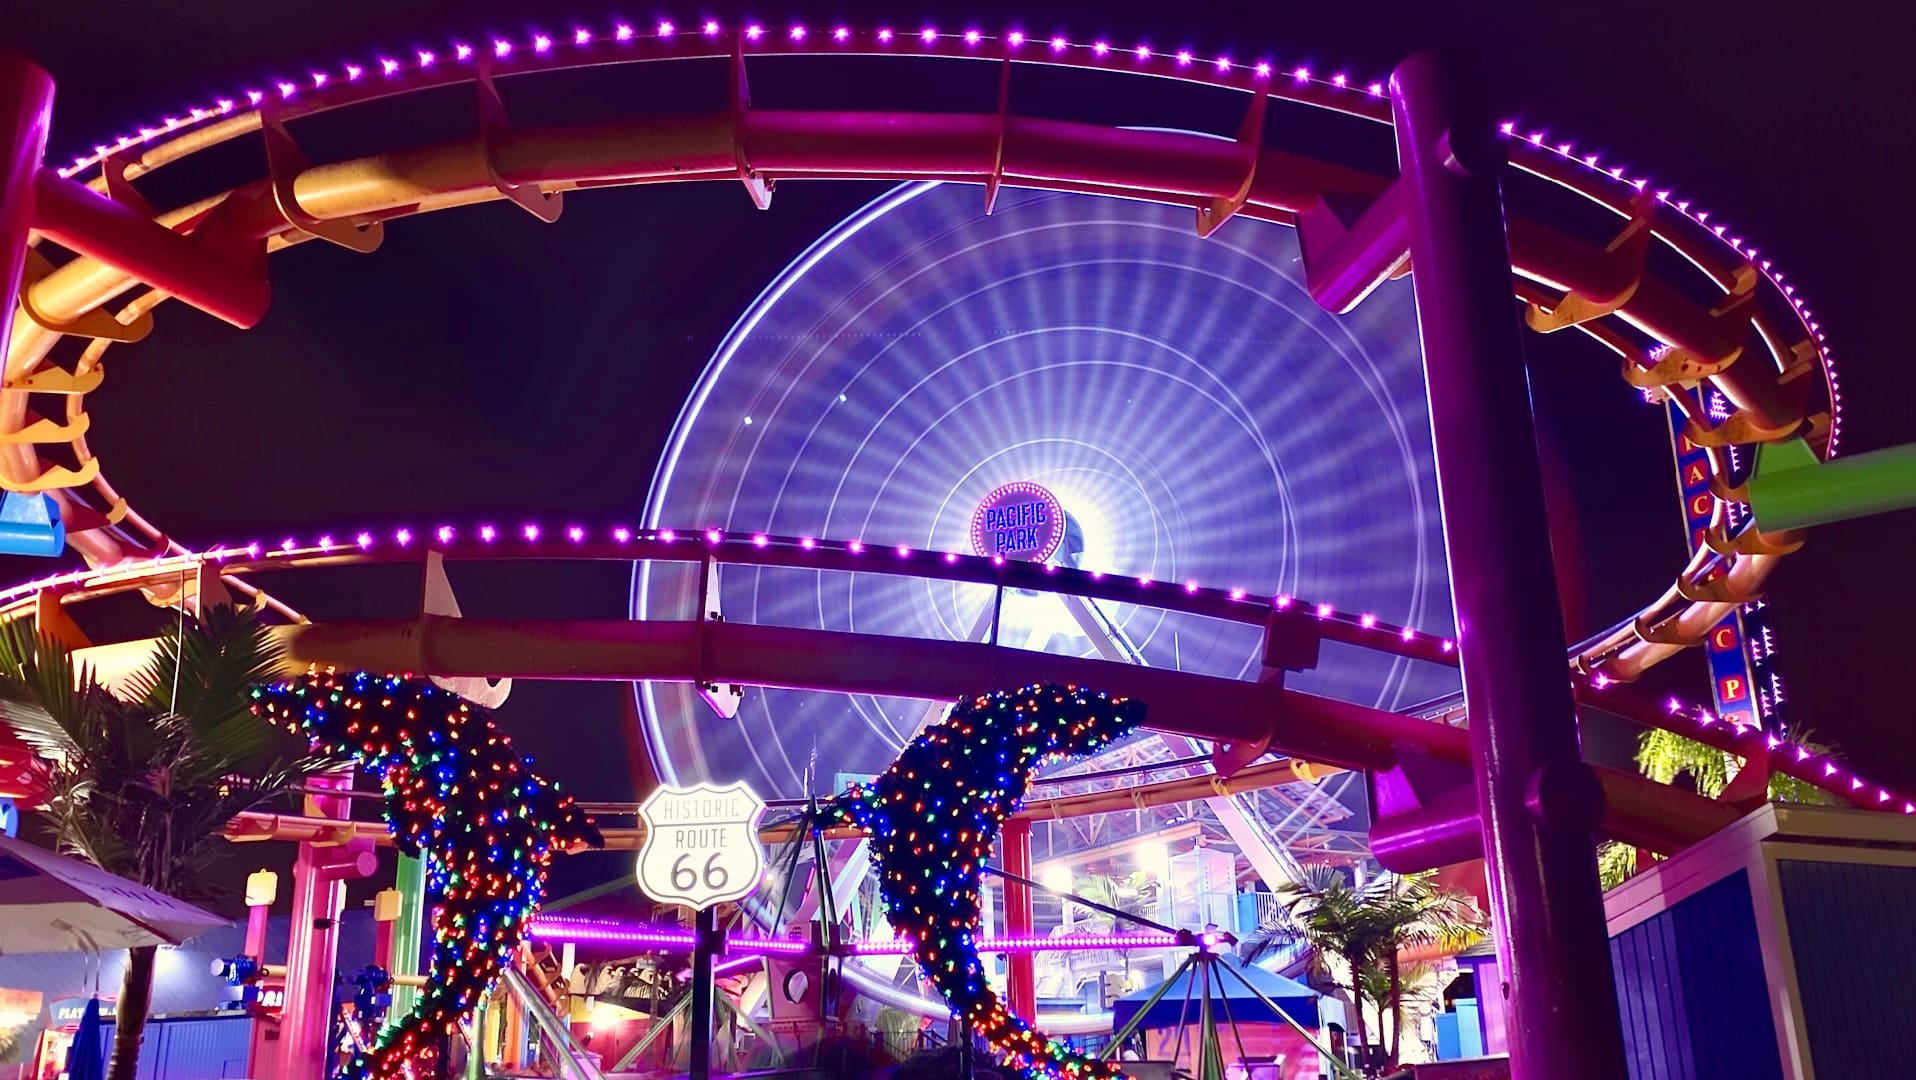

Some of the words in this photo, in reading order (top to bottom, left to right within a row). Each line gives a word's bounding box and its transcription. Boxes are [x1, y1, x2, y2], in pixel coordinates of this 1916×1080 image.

[985, 502, 1047, 531] PACIFIC
[996, 527, 1038, 553] PARK
[664, 798, 740, 819] HISTORIC
[675, 828, 727, 849] ROUTE
[671, 852, 729, 892] 66
